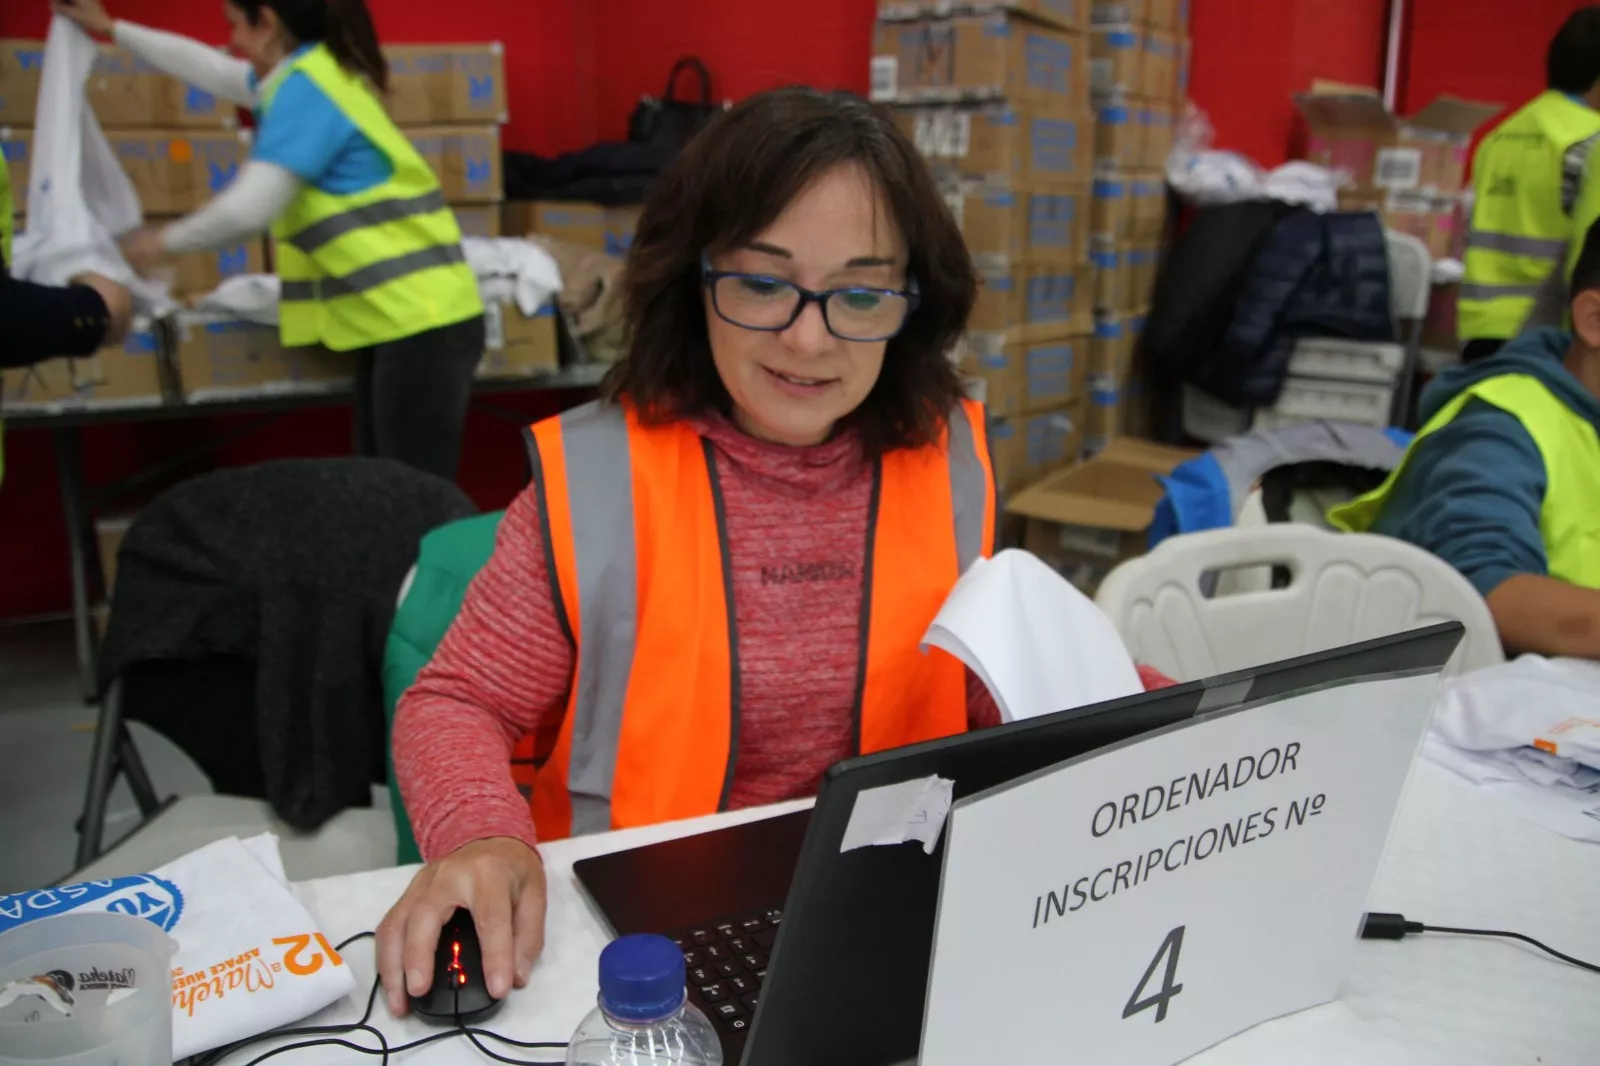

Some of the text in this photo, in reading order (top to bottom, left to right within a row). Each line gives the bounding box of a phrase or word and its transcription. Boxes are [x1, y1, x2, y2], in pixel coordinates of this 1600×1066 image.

[1091, 742, 1301, 838] ORDENADOR
[1032, 793, 1326, 928] INSCRIPCIONES Nº
[172, 957, 274, 1017] March
[210, 947, 260, 975] ASPACE
[1122, 925, 1186, 1024] 4
